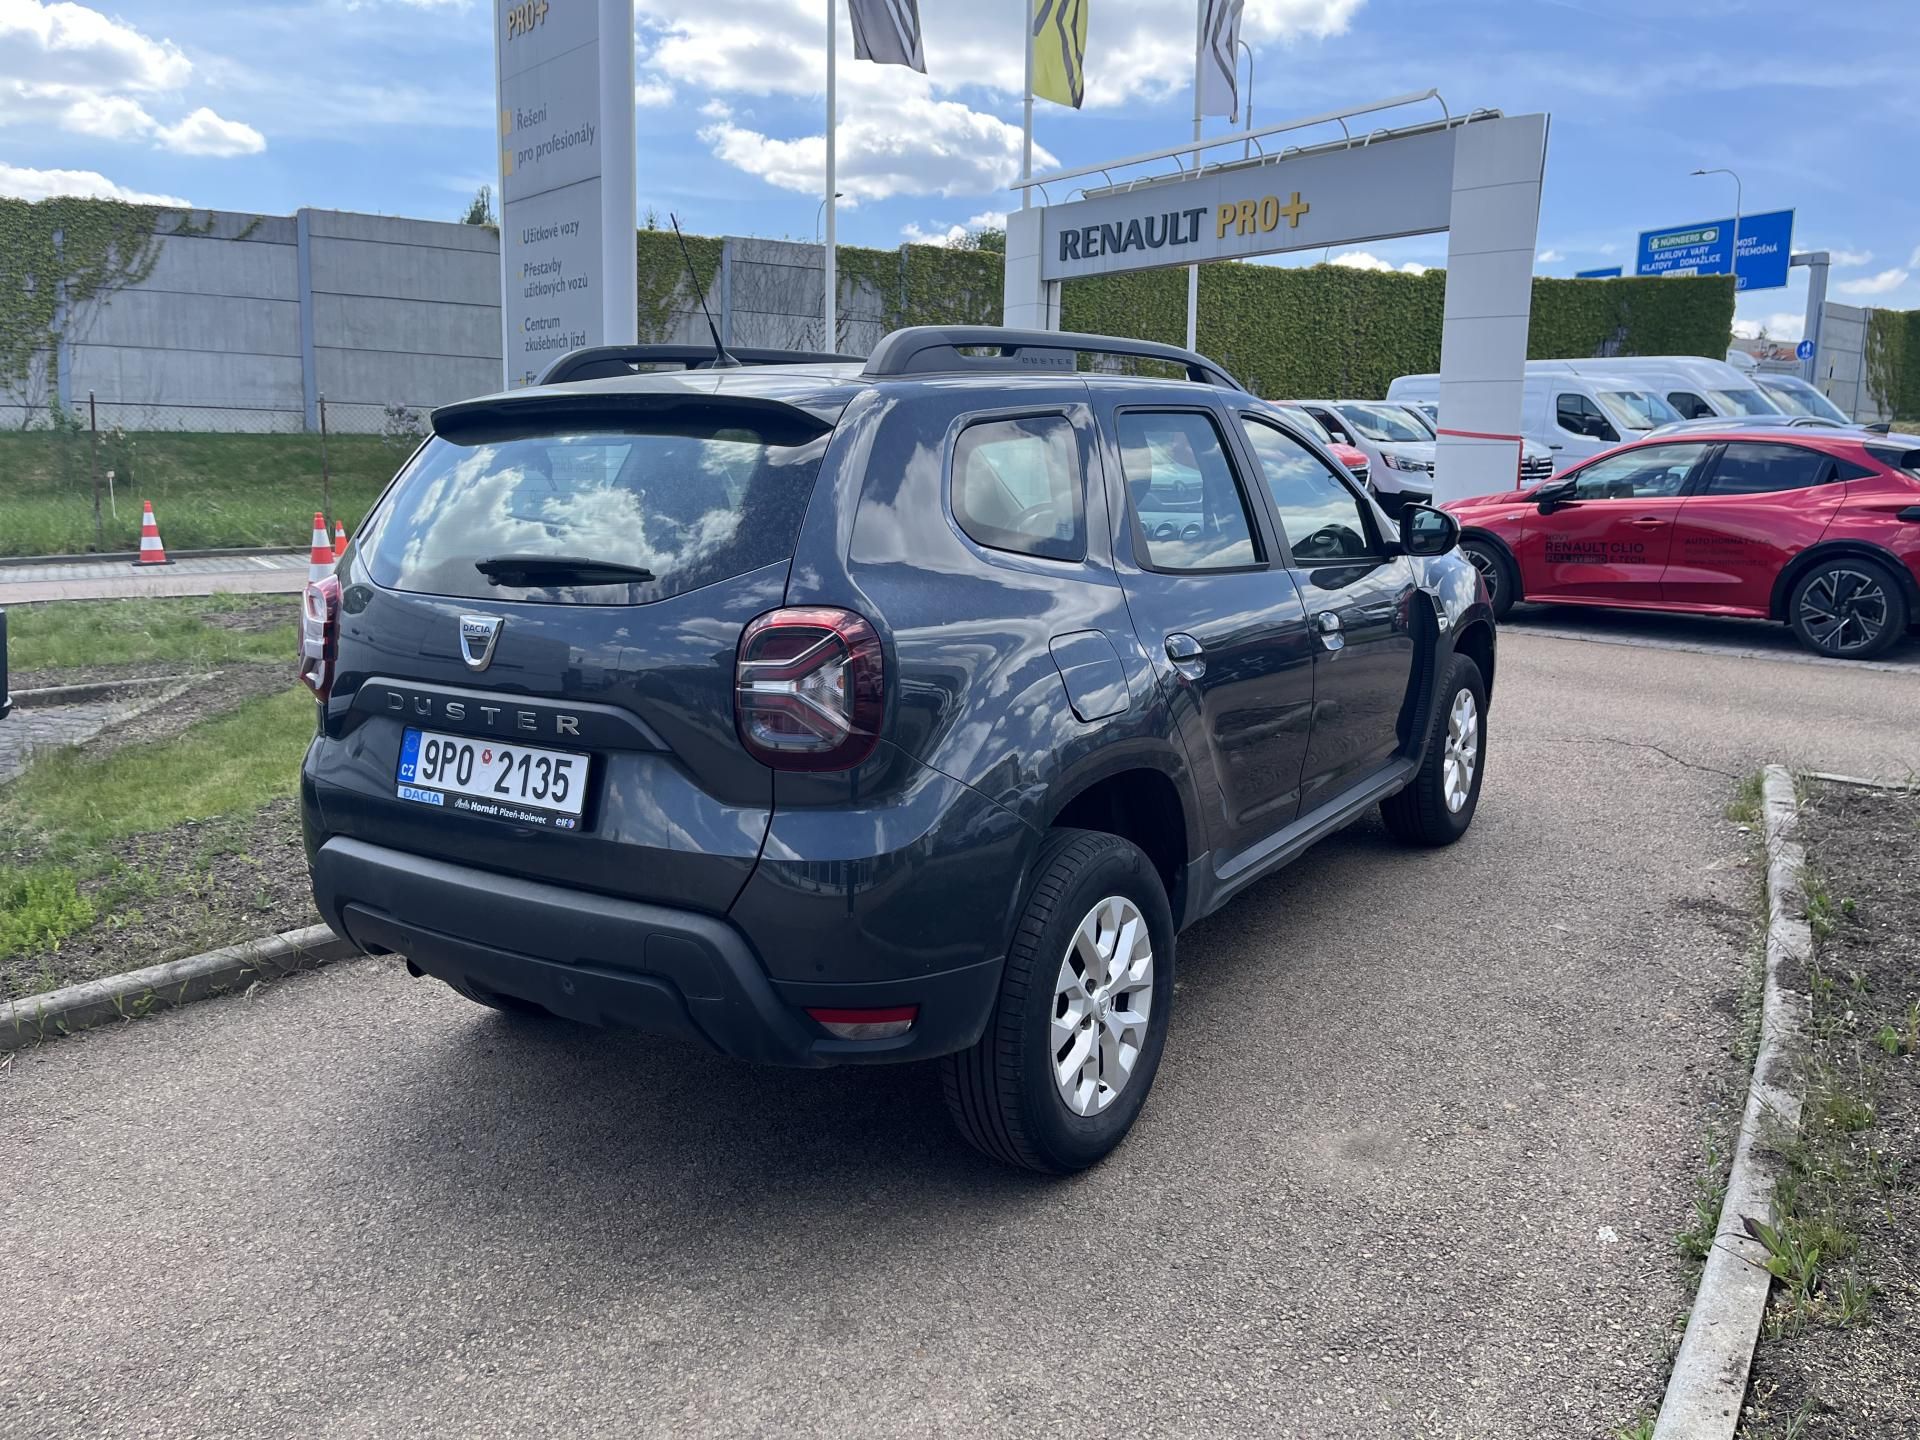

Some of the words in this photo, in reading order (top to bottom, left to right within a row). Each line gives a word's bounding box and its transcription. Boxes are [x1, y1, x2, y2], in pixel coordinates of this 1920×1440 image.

[507, 0, 549, 41] PRO+
[516, 103, 548, 131] Řešení
[518, 149, 534, 168] pro
[536, 122, 596, 163] profesionály
[522, 222, 558, 245] Užitkové
[560, 221, 580, 235] vozy
[1059, 207, 1208, 262] RENAULT
[1215, 191, 1310, 239] PRO+
[1660, 233, 1700, 248] NÜRNBERG
[1736, 236, 1758, 247] MOST
[1641, 260, 1673, 272] KLATOVY
[1679, 253, 1721, 267] DOMAŽLICE
[1653, 249, 1688, 261] KARLOVY
[1690, 246, 1710, 255] VARY
[523, 258, 562, 278] Přestavby
[524, 278, 566, 298] užitkových
[567, 273, 588, 289] vozů
[524, 317, 561, 332] Centrum
[525, 334, 568, 352] zkušebních
[570, 331, 586, 351] jízd
[1022, 357, 1072, 365] DUSTER
[1545, 541, 1608, 553] RENAULT
[1610, 542, 1645, 553] CLIO
[463, 624, 490, 634] DACIA
[387, 692, 580, 735] DUSTER
[401, 763, 415, 777] CZ
[494, 751, 573, 803] 2135
[403, 788, 441, 805] DACIA
[470, 801, 498, 815] Hornát
[499, 807, 547, 825] Plzeň-Bolevec
